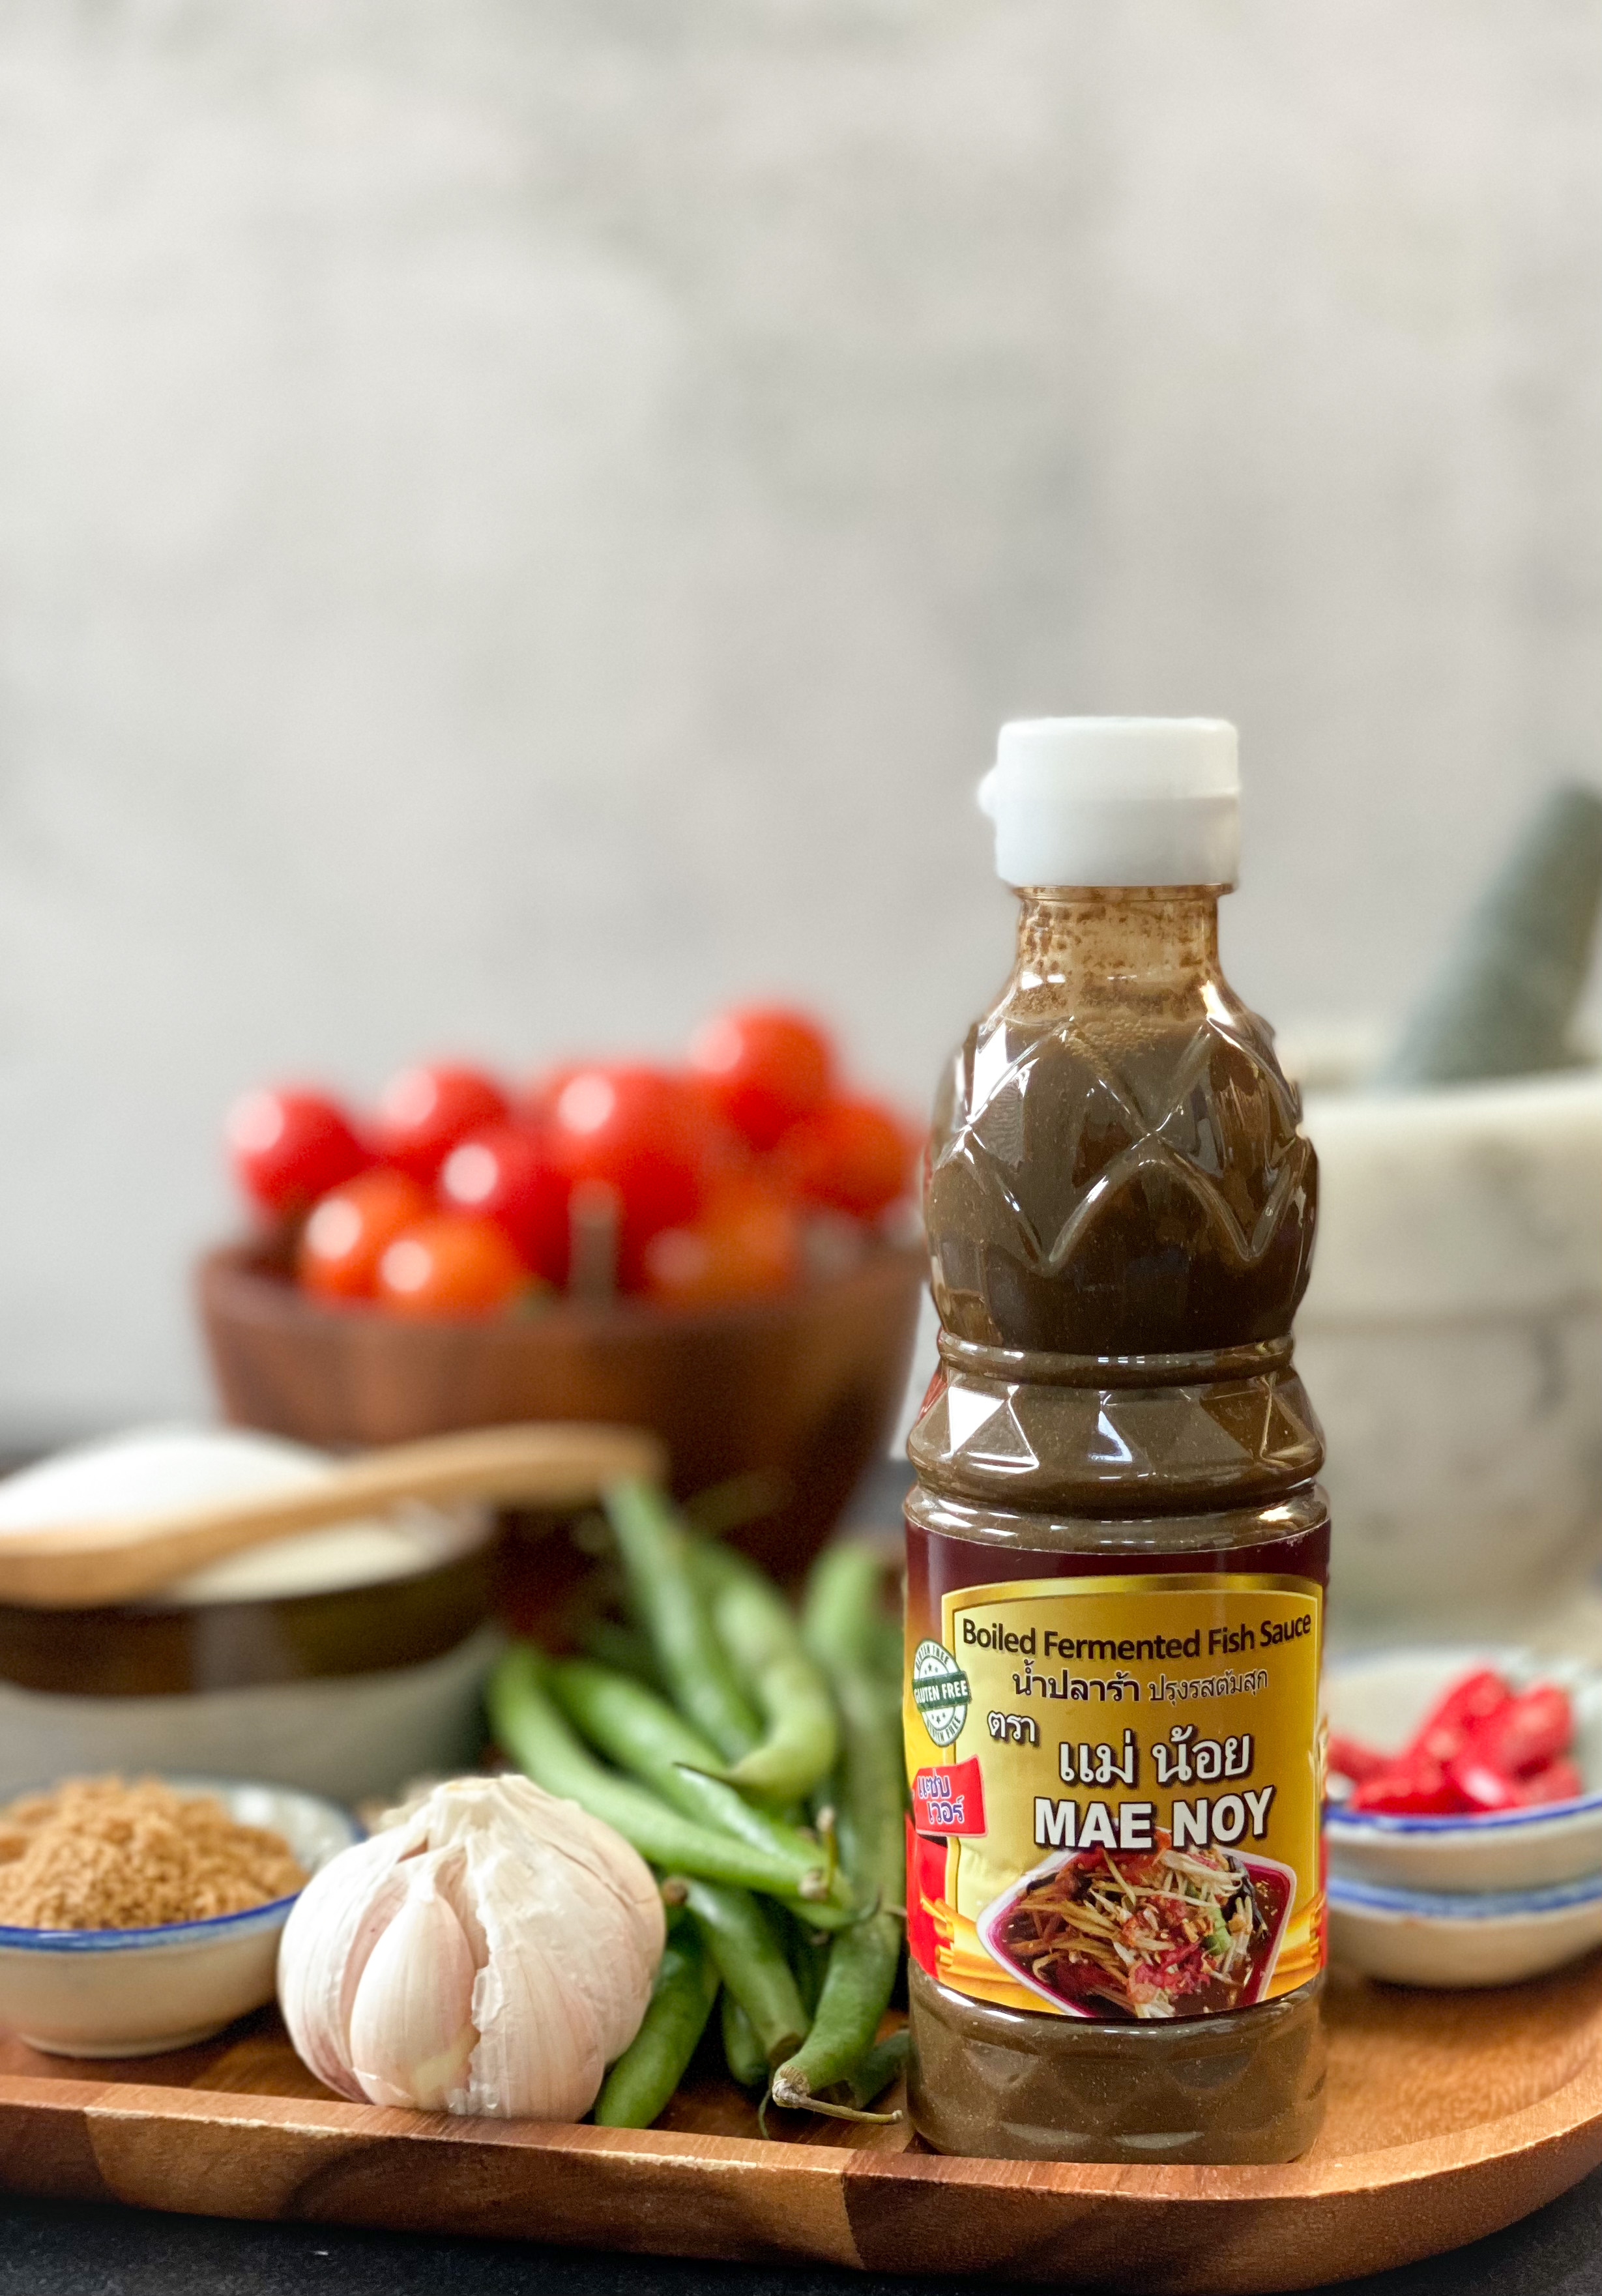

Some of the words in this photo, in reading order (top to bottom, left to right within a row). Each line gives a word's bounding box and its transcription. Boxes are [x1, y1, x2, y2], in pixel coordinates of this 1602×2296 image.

[963, 1618, 1035, 1655] Boiled
[1044, 1630, 1201, 1660] Fermented
[1208, 1624, 1254, 1654] Fish
[1260, 1612, 1311, 1646] Sauce
[914, 1685, 940, 1704] GLUTEN
[942, 1680, 968, 1698] FREE
[1013, 1659, 1139, 1702] น้ำปลาร้า
[987, 1710, 1037, 1743] ตรา
[1059, 1728, 1134, 1784] แม่
[1152, 1724, 1251, 1784] น้อย
[1035, 1796, 1152, 1848] MAE
[1172, 1786, 1274, 1846] NOY
